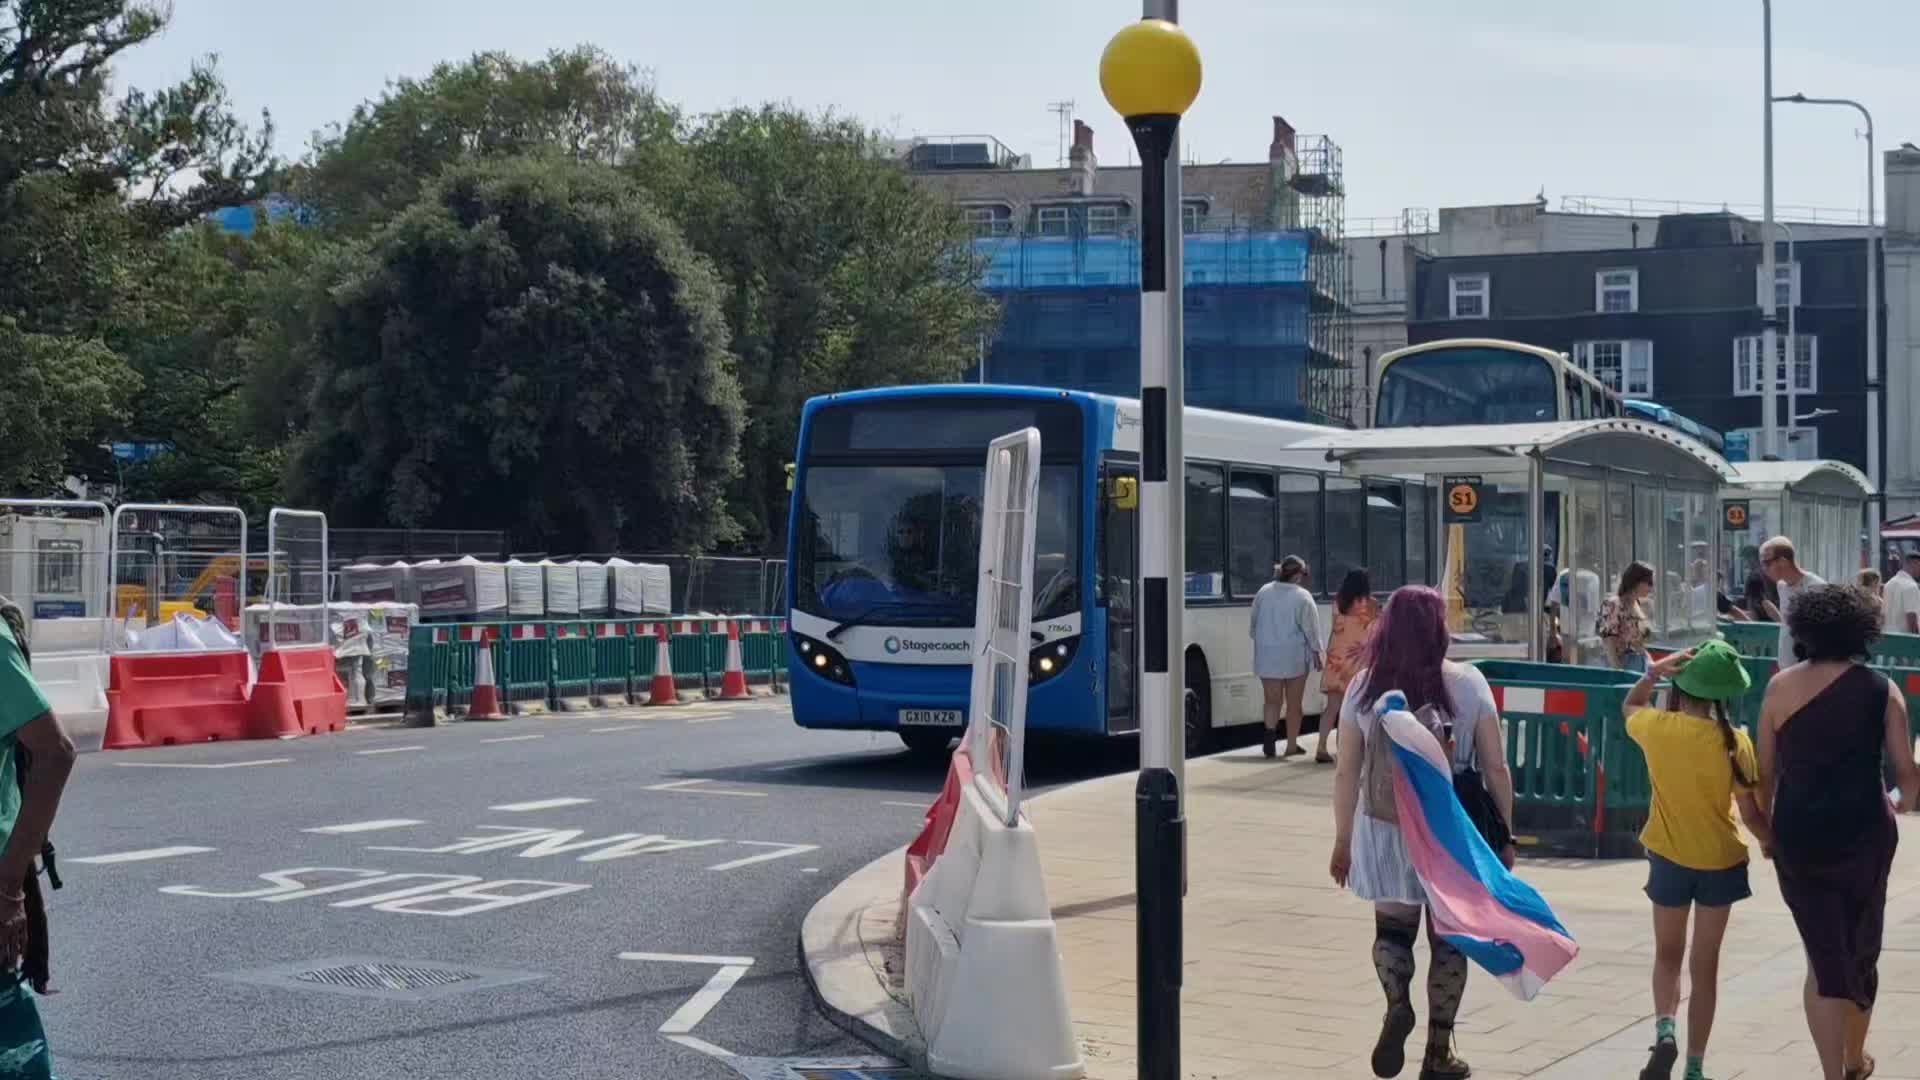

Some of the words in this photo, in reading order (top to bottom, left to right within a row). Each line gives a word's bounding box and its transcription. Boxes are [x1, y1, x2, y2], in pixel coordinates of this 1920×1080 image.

[1452, 491, 1473, 506] S1
[902, 639, 970, 653] Stagecoach
[368, 826, 819, 871] LANE
[158, 867, 592, 916] BUS
